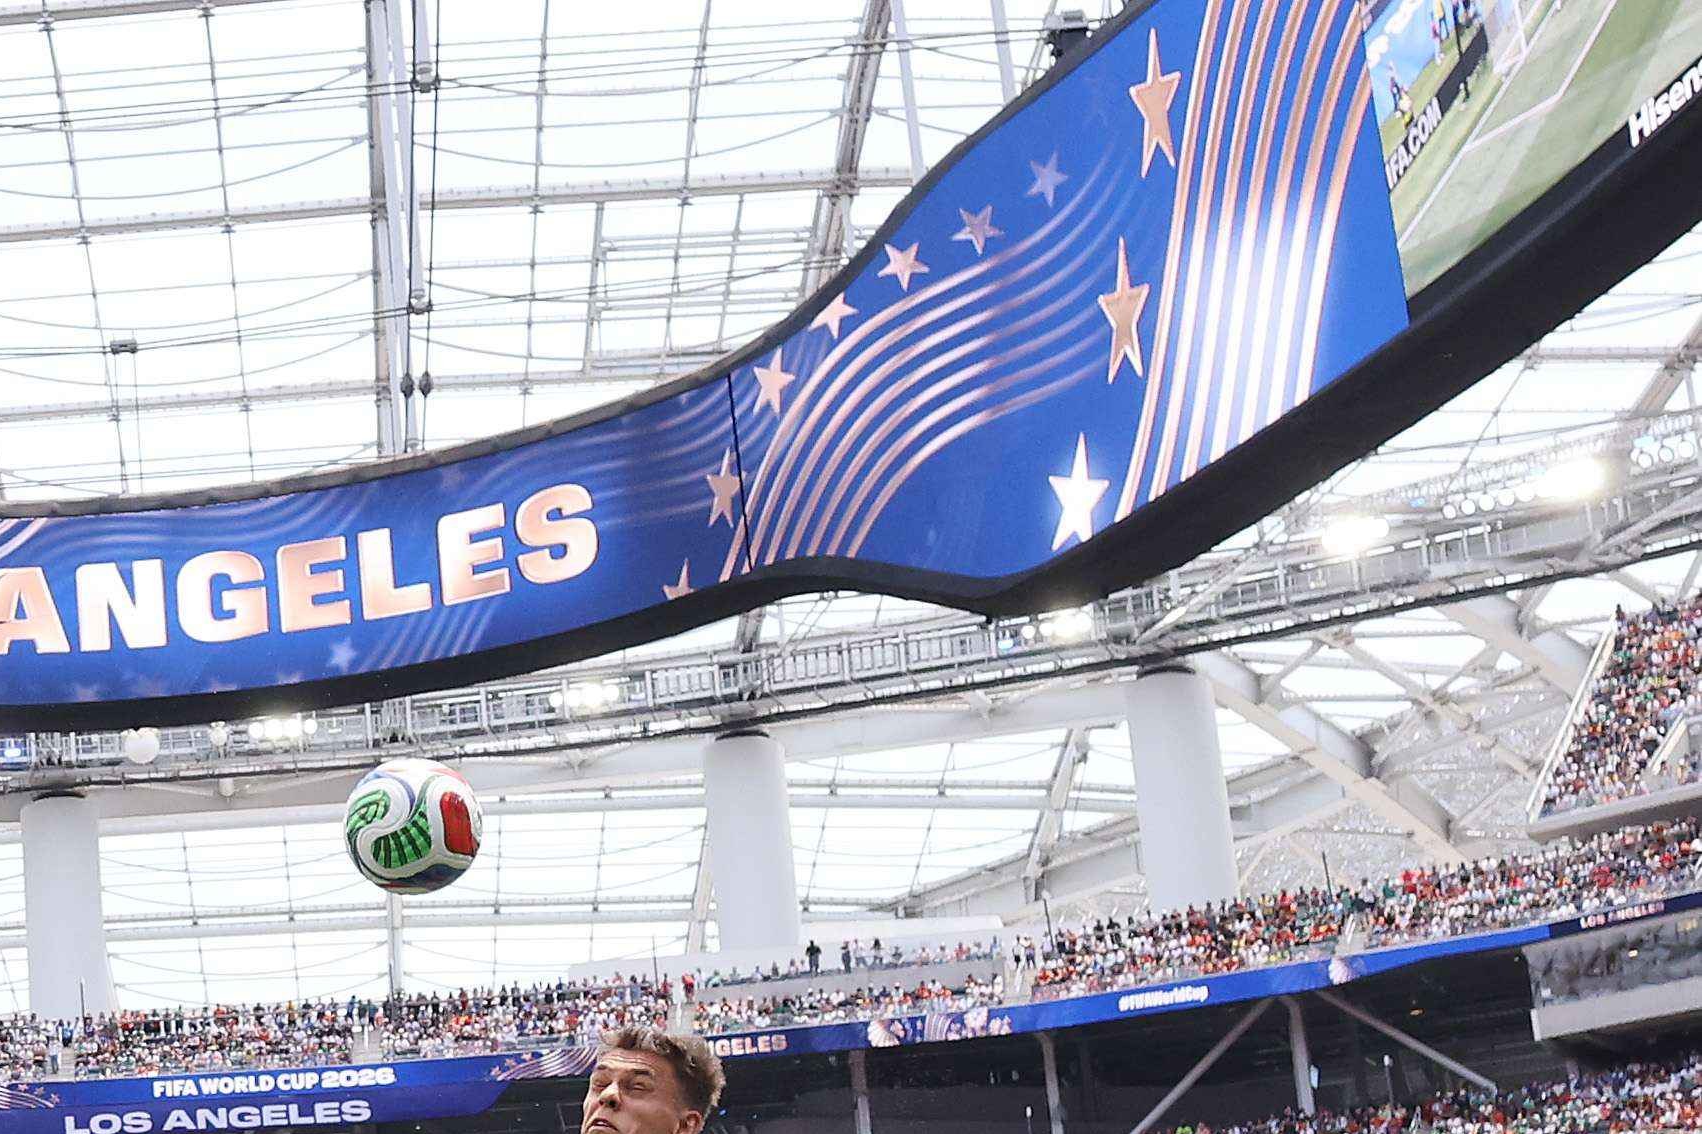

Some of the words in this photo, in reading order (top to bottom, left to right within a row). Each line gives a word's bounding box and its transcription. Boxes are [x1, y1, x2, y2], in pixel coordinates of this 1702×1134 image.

[708, 1035, 788, 1058] GELES
[152, 1078, 198, 1098] FIFA
[199, 1074, 274, 1097] WORLD
[276, 1071, 320, 1091] CUP
[320, 1067, 397, 1088] 2026
[162, 1099, 372, 1131] ANGELES
